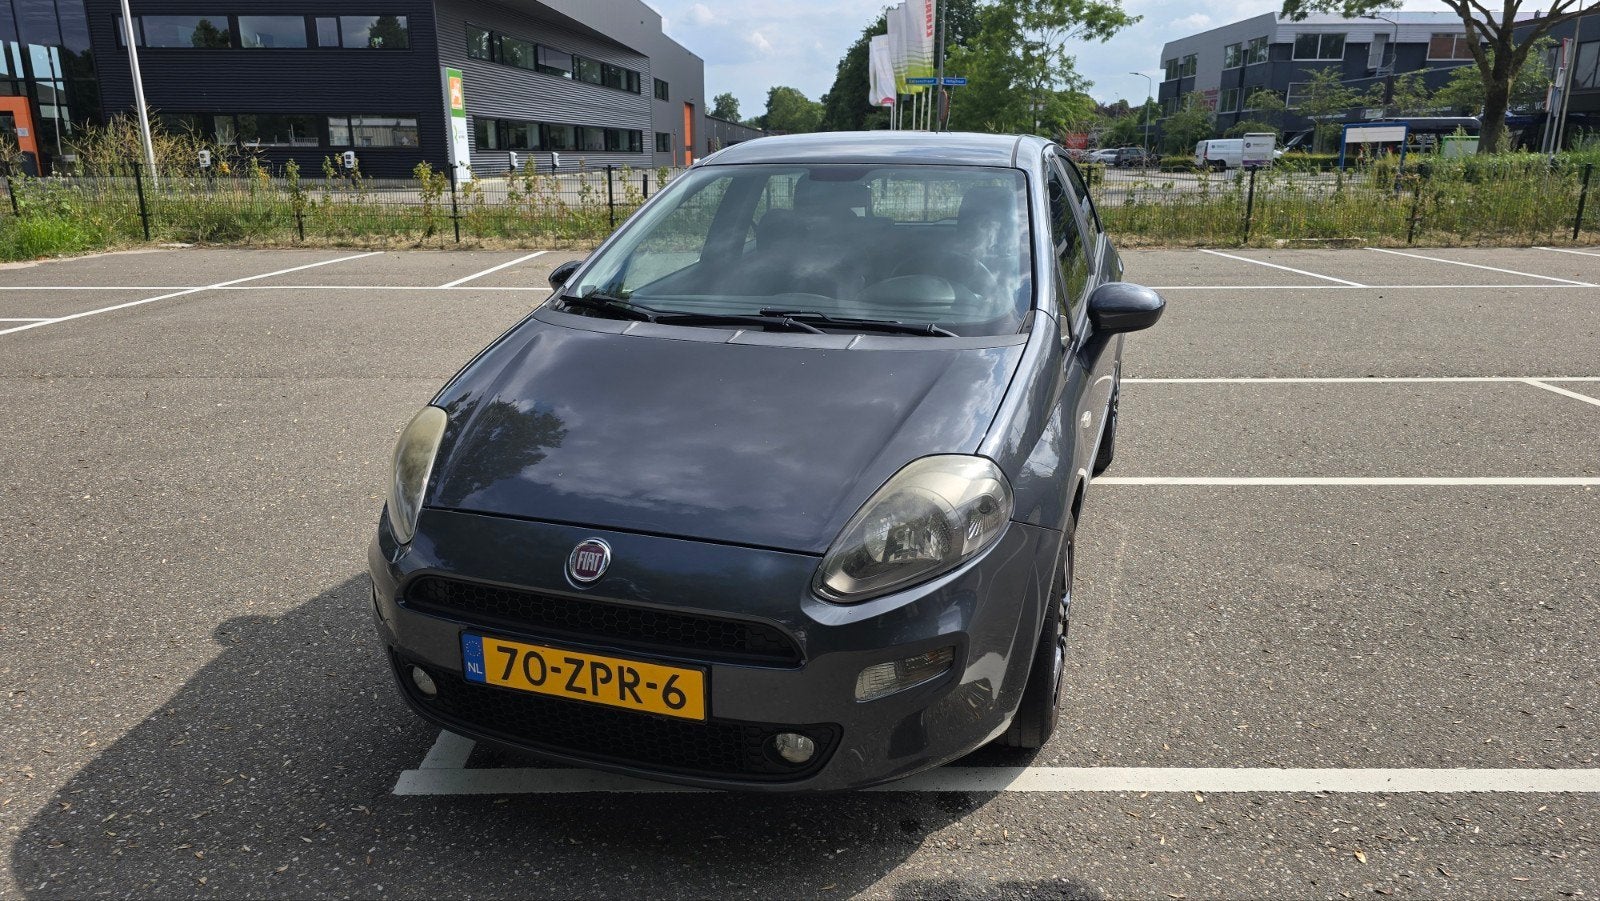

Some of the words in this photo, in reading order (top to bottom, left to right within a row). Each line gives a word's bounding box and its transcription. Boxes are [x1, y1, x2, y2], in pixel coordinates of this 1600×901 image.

[576, 551, 602, 571] FIAT
[467, 661, 483, 675] NL
[496, 645, 687, 710] 70-ZPR-6
